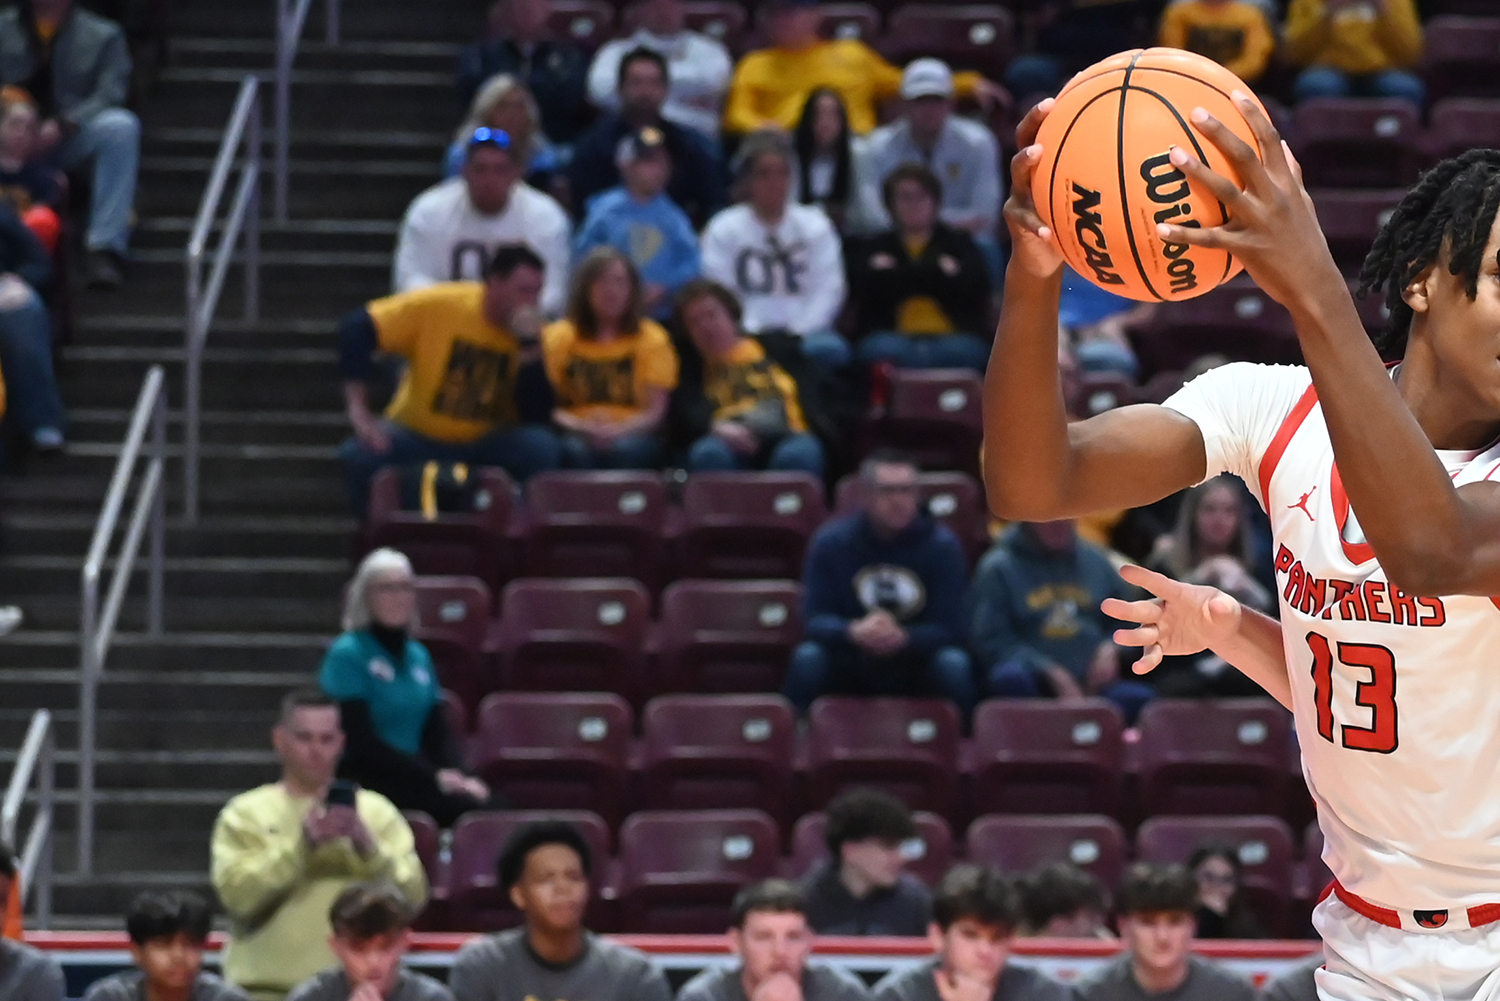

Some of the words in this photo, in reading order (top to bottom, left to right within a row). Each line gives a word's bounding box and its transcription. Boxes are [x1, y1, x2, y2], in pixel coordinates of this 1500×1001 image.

[1071, 180, 1126, 286] NCAA
[1275, 542, 1447, 627] PANTHERS
[1305, 630, 1399, 754] 13
